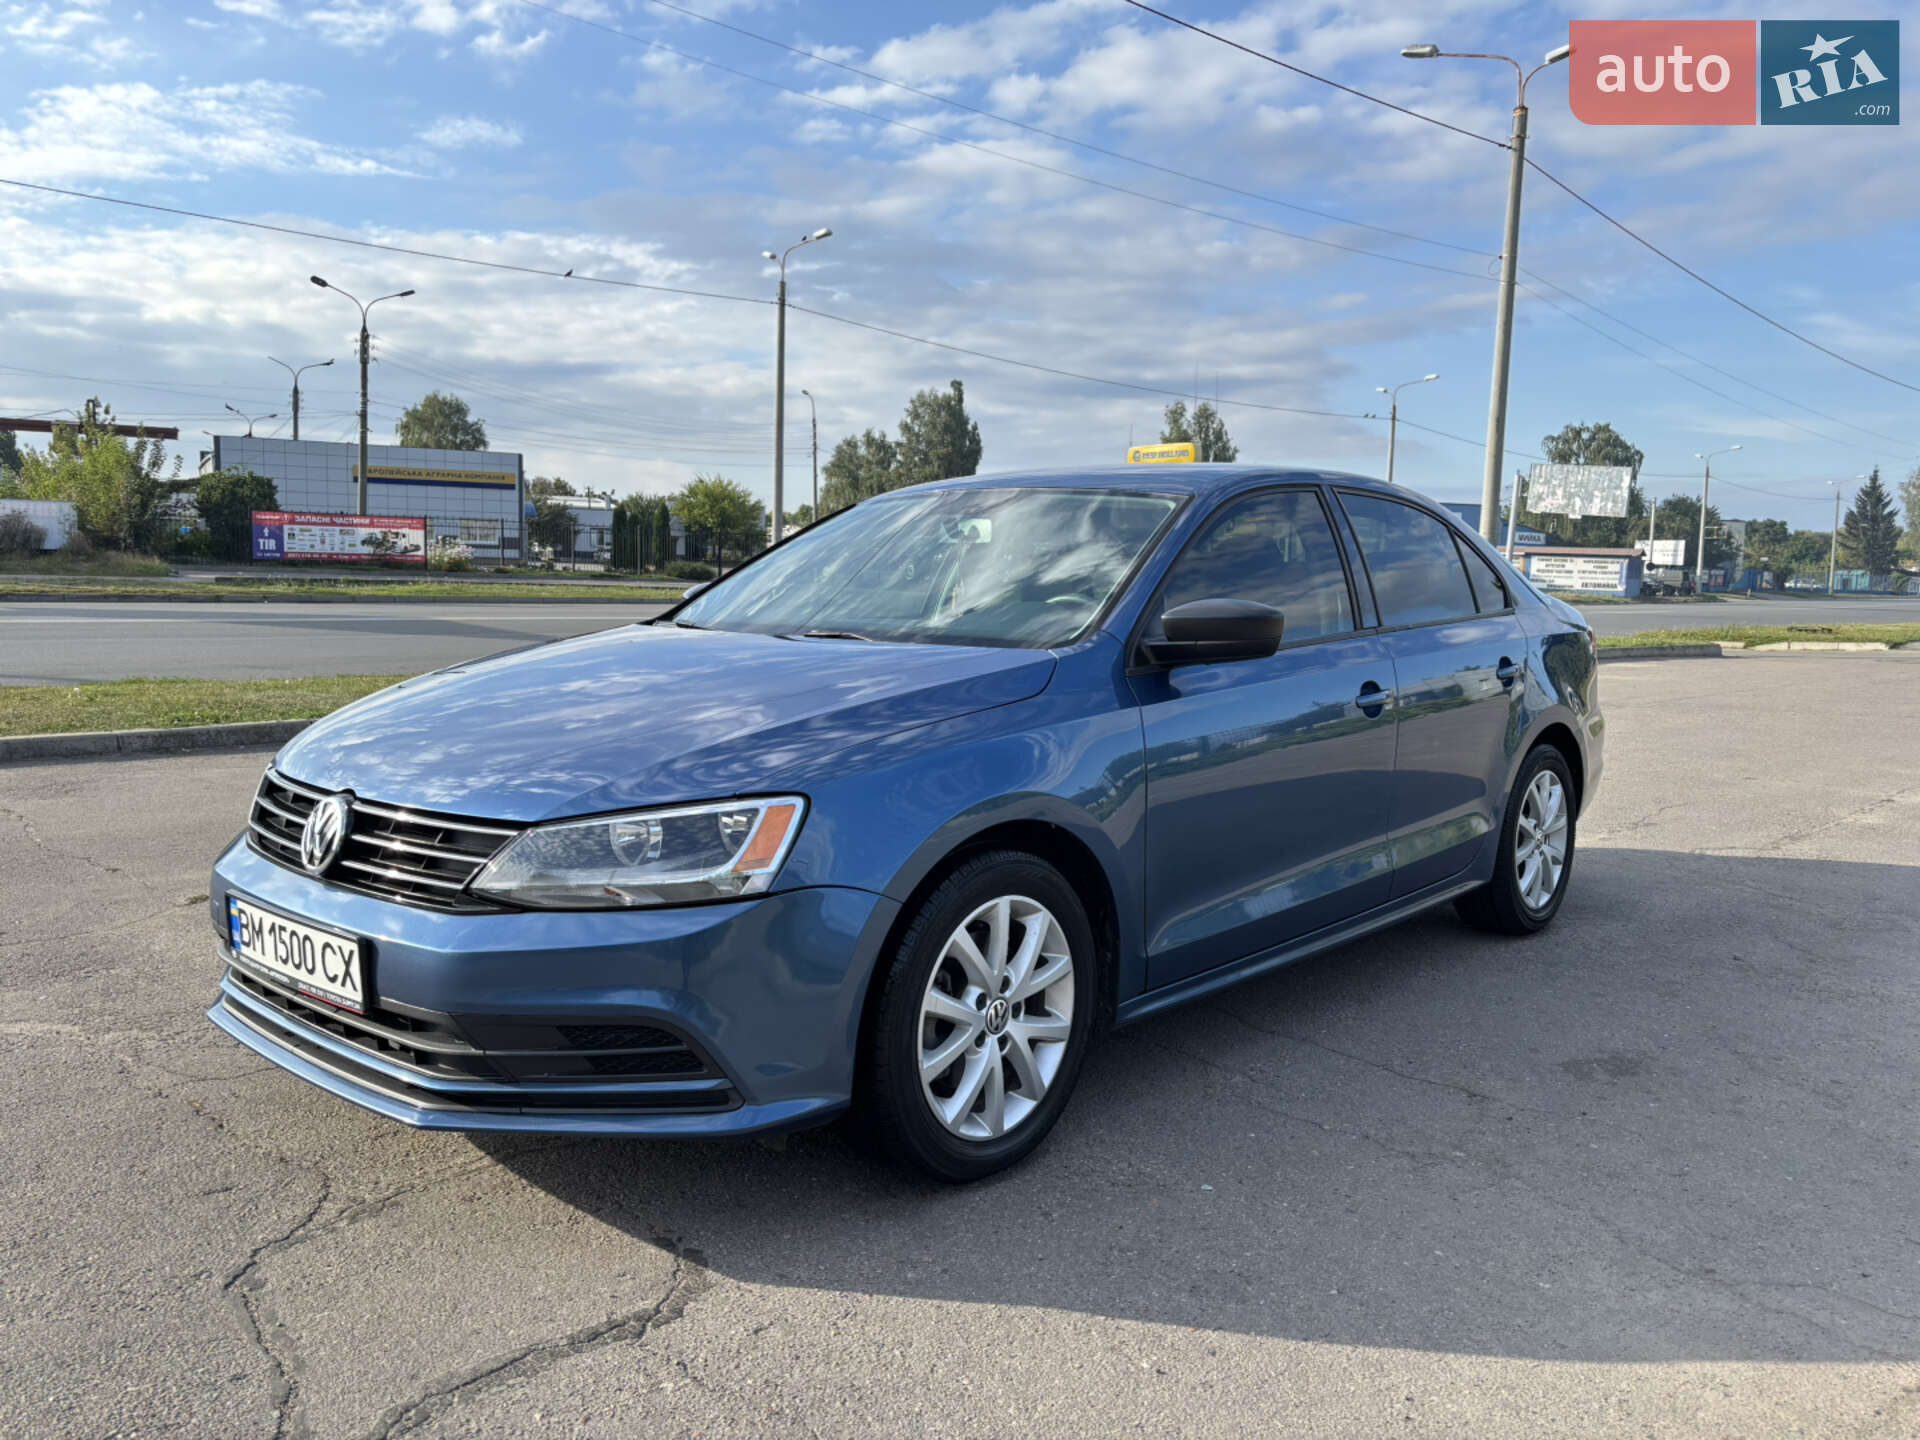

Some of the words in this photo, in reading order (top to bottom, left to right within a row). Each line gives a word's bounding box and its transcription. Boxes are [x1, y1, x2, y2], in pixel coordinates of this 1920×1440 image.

[258, 538, 277, 551] TIR
[239, 908, 265, 957] BM
[268, 921, 316, 976] 1500
[321, 941, 358, 993] CX
